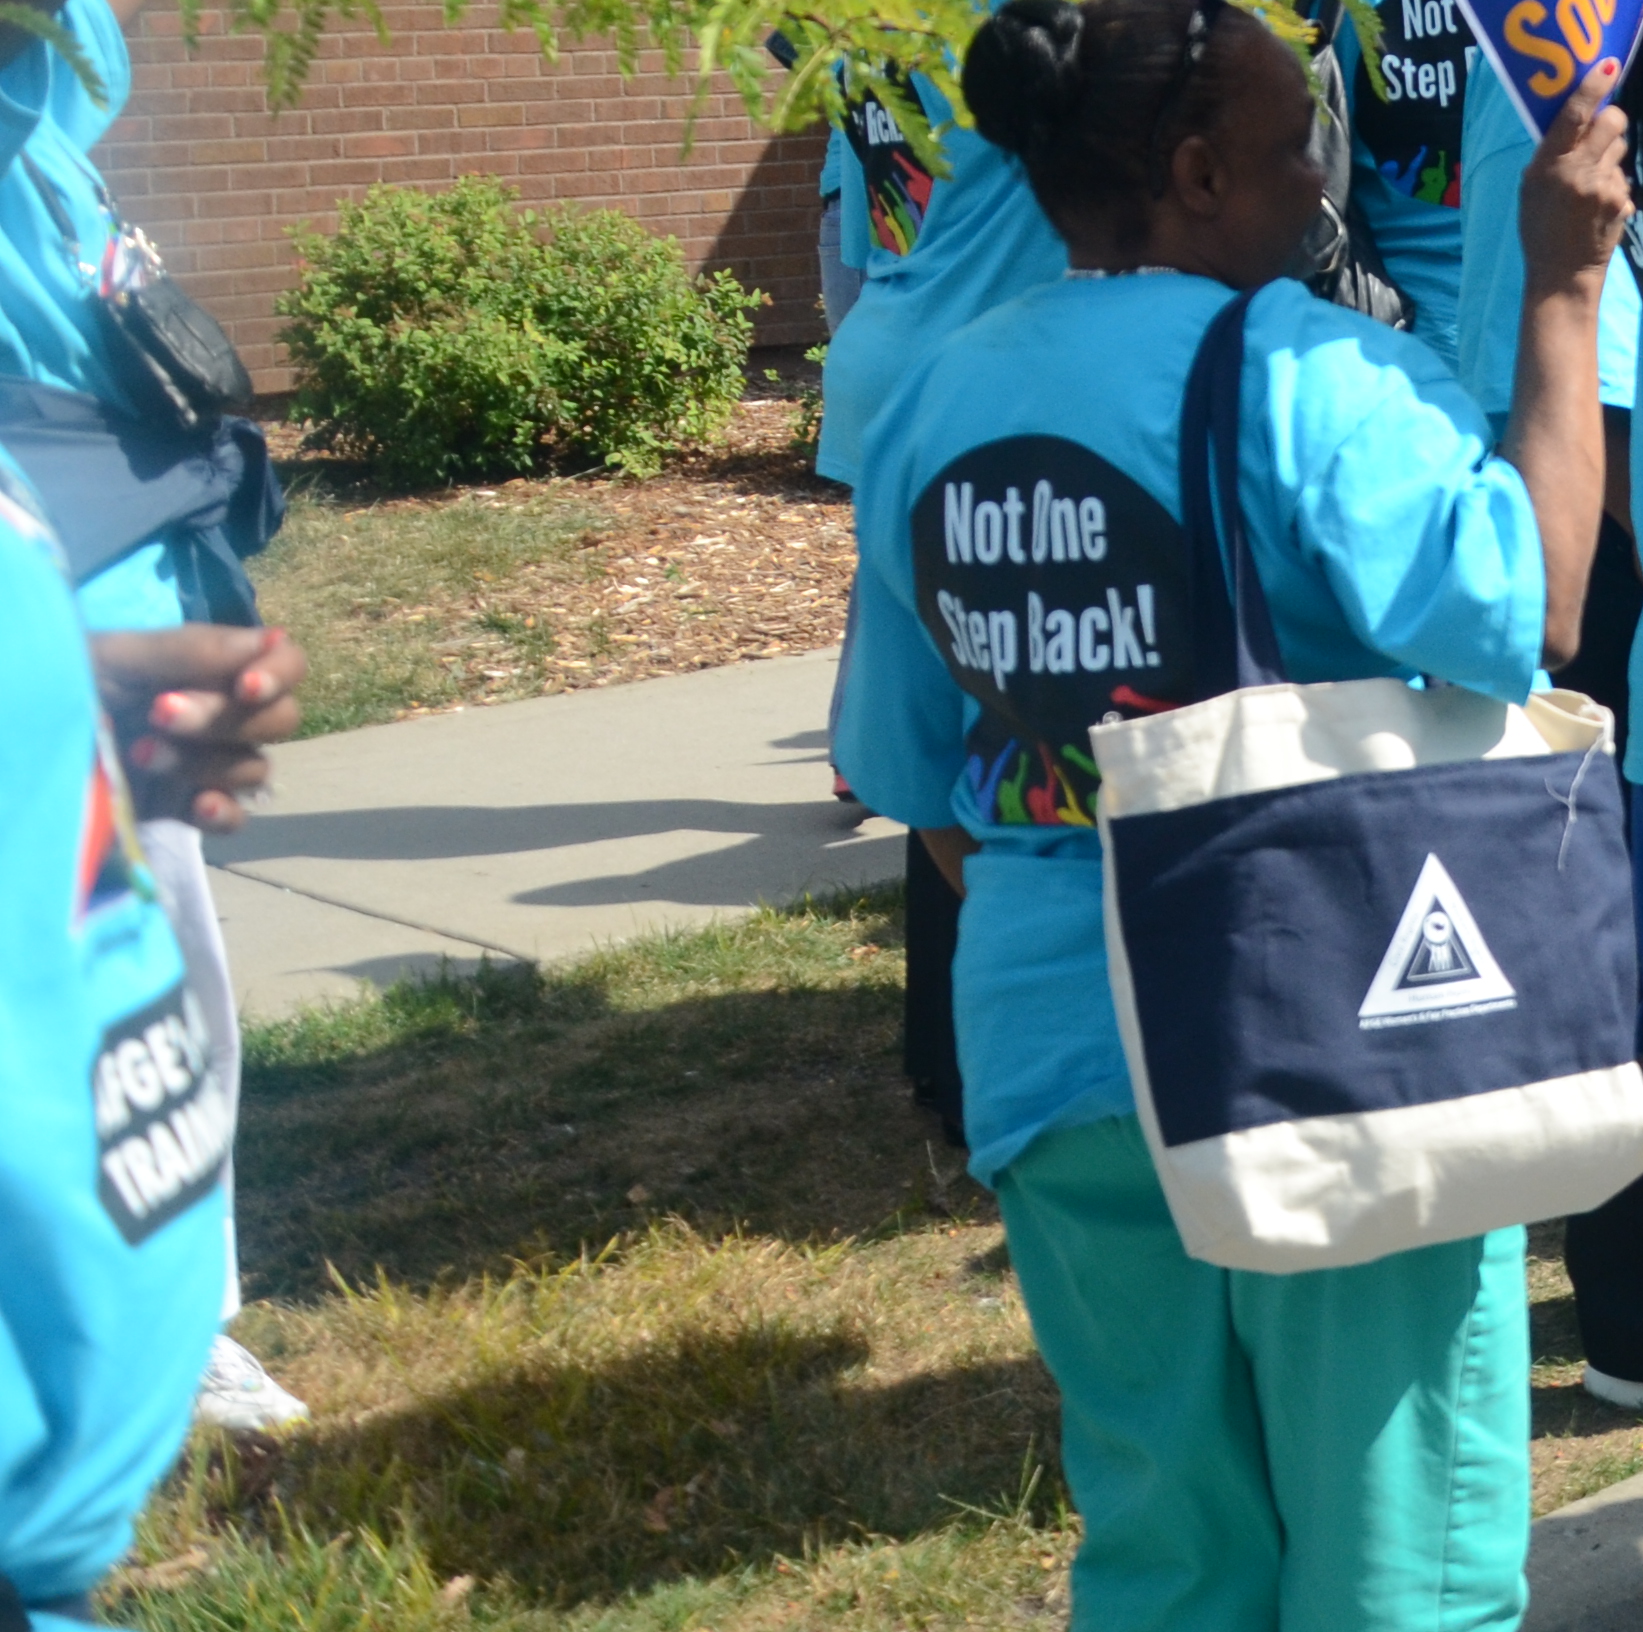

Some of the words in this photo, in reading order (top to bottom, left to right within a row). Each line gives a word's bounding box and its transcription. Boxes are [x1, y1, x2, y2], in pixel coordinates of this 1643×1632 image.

[1381, 53, 1457, 108] Step
[943, 480, 1027, 565] Not
[1031, 478, 1108, 565] One
[936, 588, 1019, 694] Step
[1027, 583, 1162, 675] Back!
